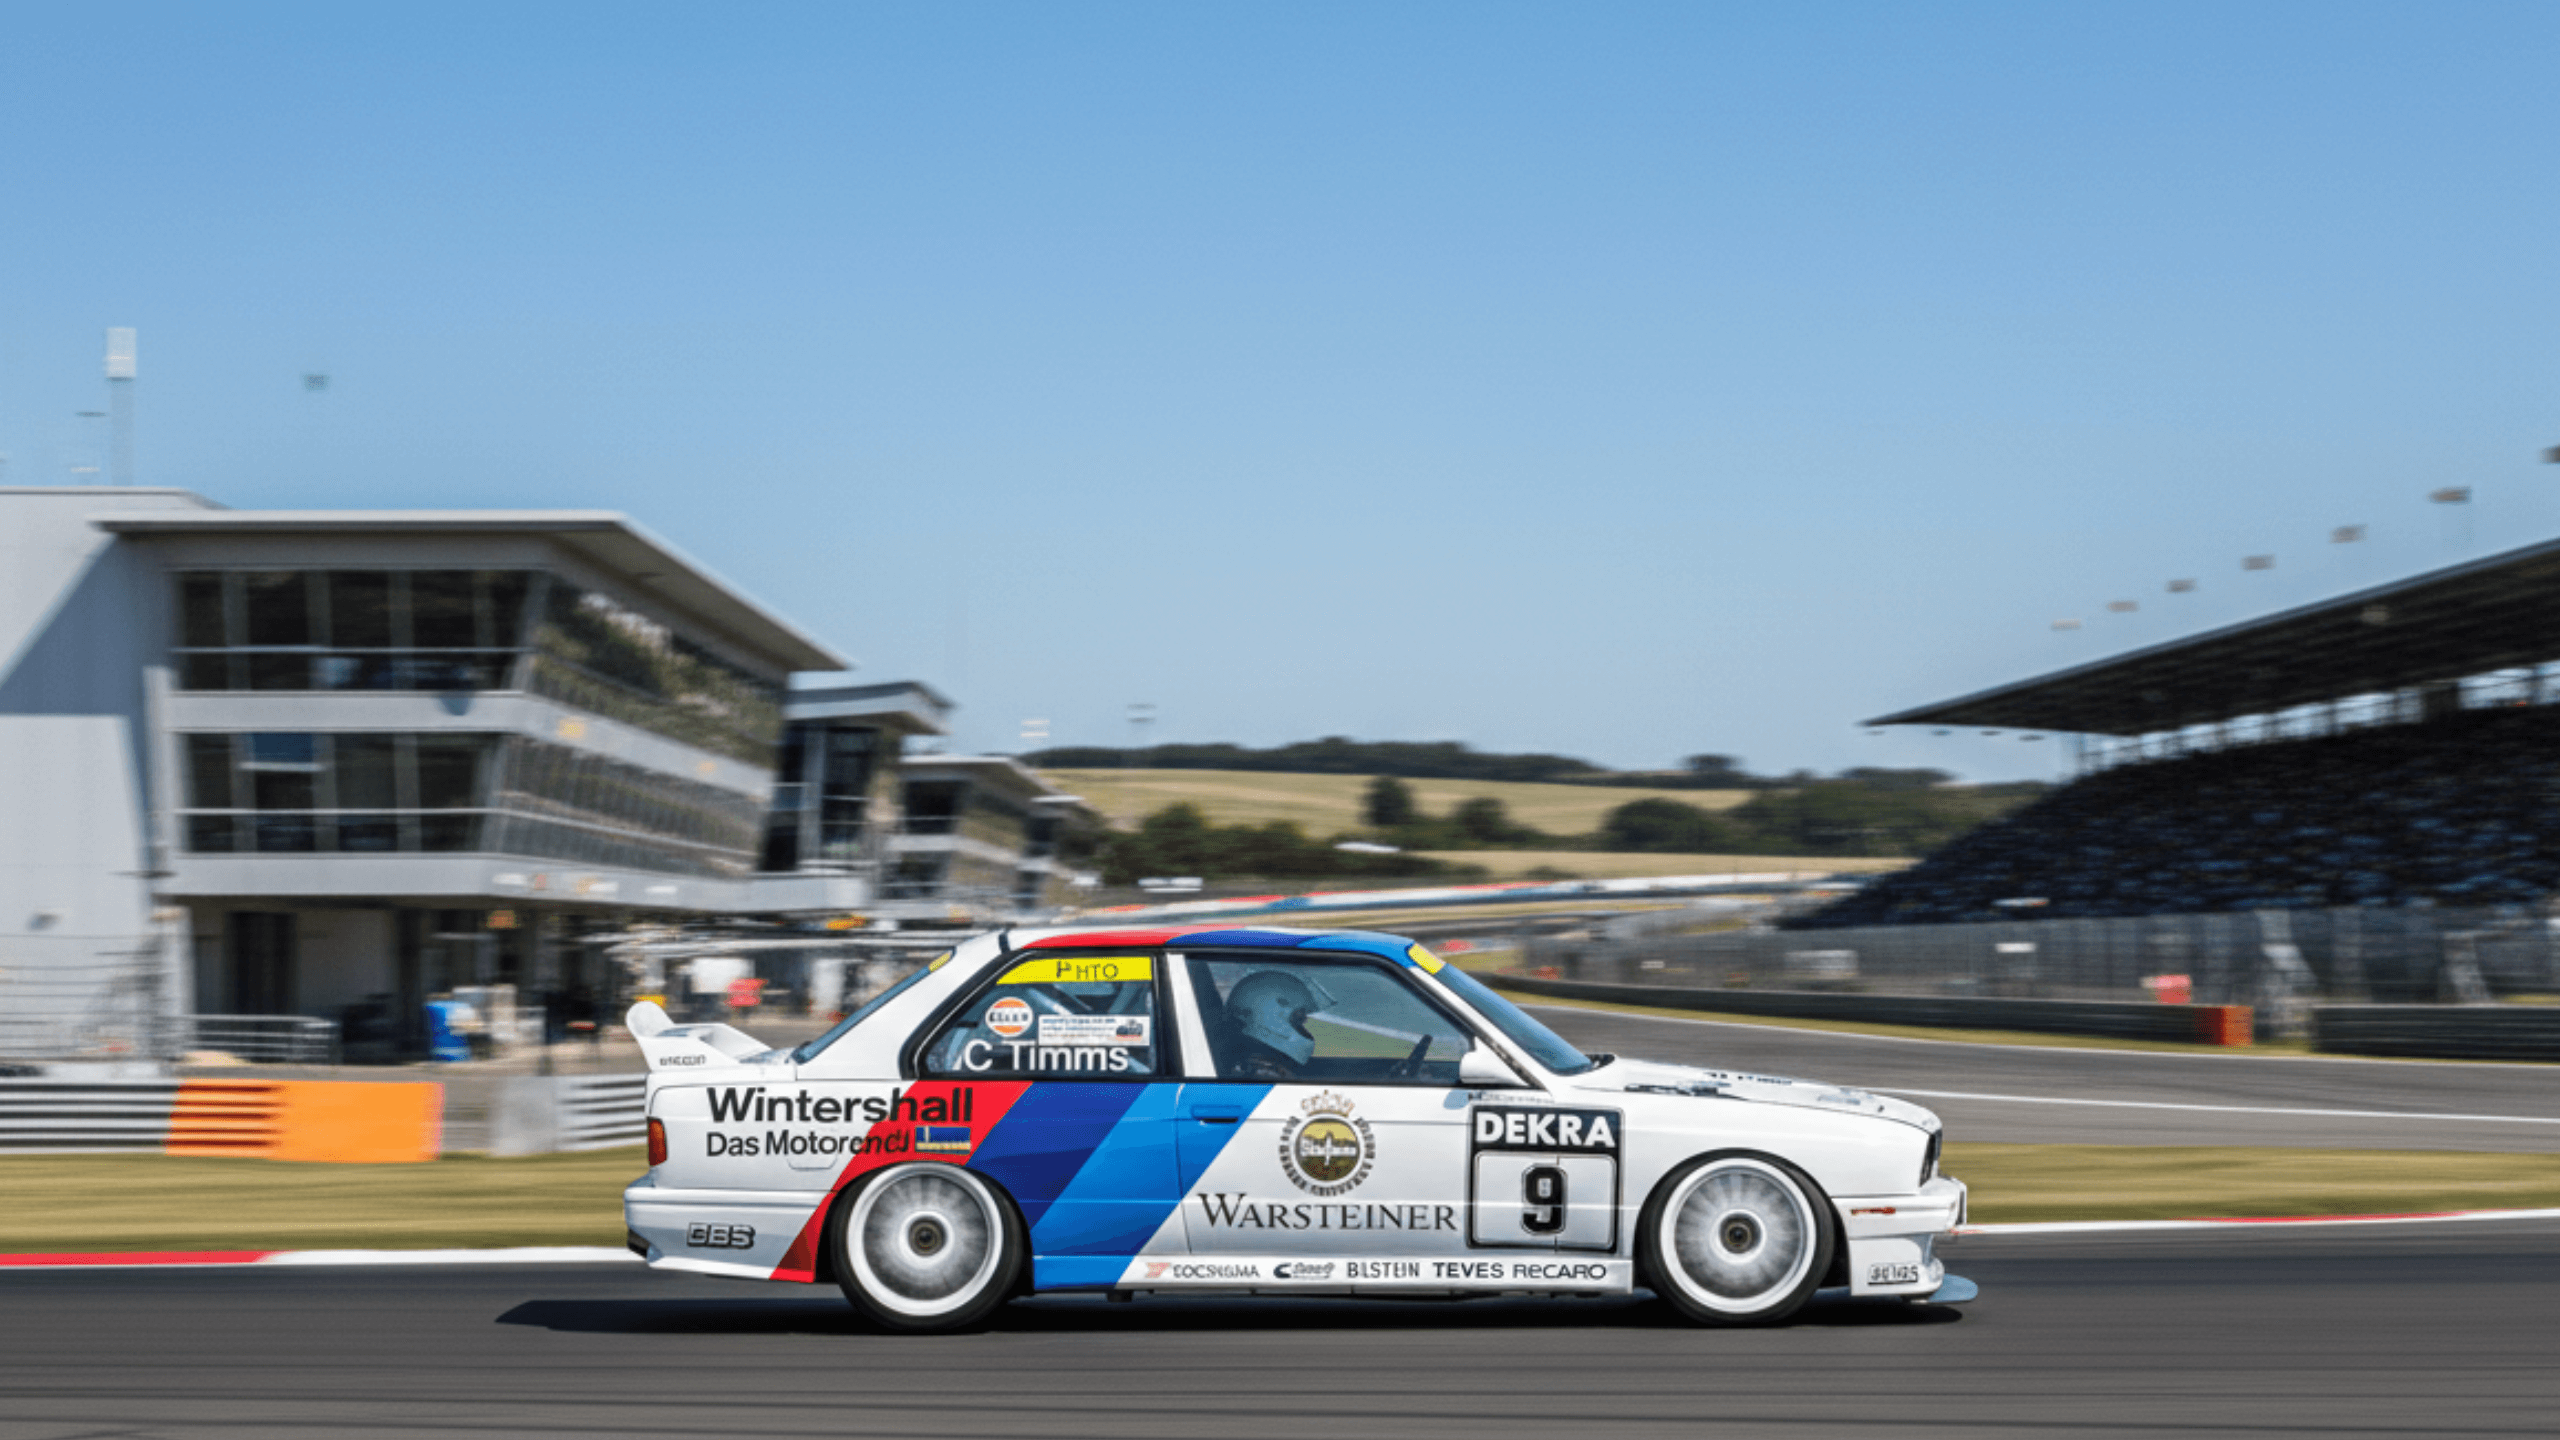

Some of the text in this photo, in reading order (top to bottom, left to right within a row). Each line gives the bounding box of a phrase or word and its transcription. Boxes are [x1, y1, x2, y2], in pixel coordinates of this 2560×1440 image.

[963, 1038, 1129, 1072] C Timms
[706, 1087, 973, 1123] Wintershall
[706, 1131, 760, 1157] Das
[1475, 1111, 1615, 1147] DEKRA
[1197, 1193, 1458, 1231] WARSTEINER
[1521, 1163, 1567, 1235] 9
[1433, 1261, 1504, 1279] TEVES
